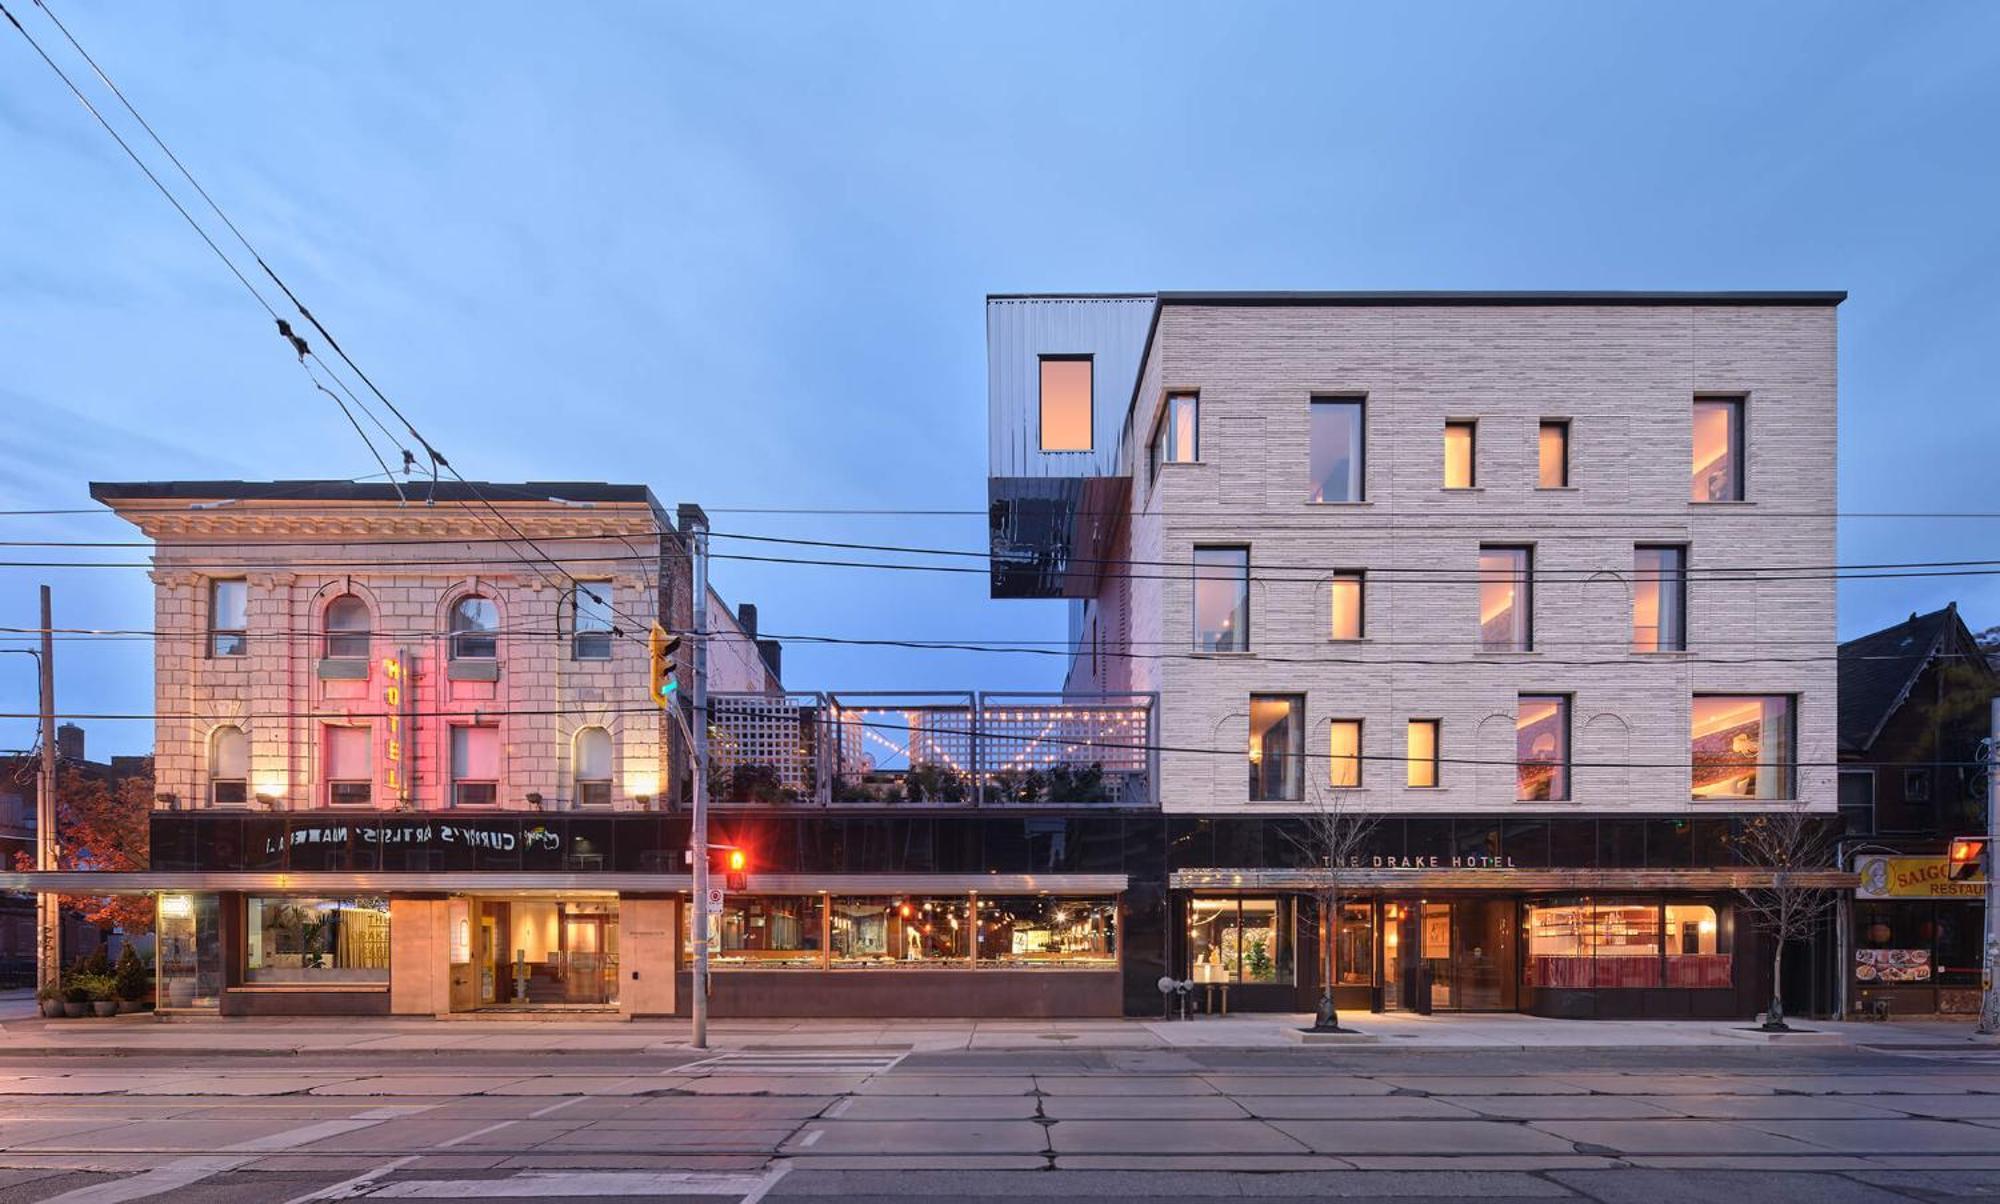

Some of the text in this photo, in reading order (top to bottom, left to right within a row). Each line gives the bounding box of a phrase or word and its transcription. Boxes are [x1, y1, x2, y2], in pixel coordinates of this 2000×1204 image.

[383, 657, 400, 790] HOTEL
[1322, 855, 1516, 868] THE DRAKE HOTEL
